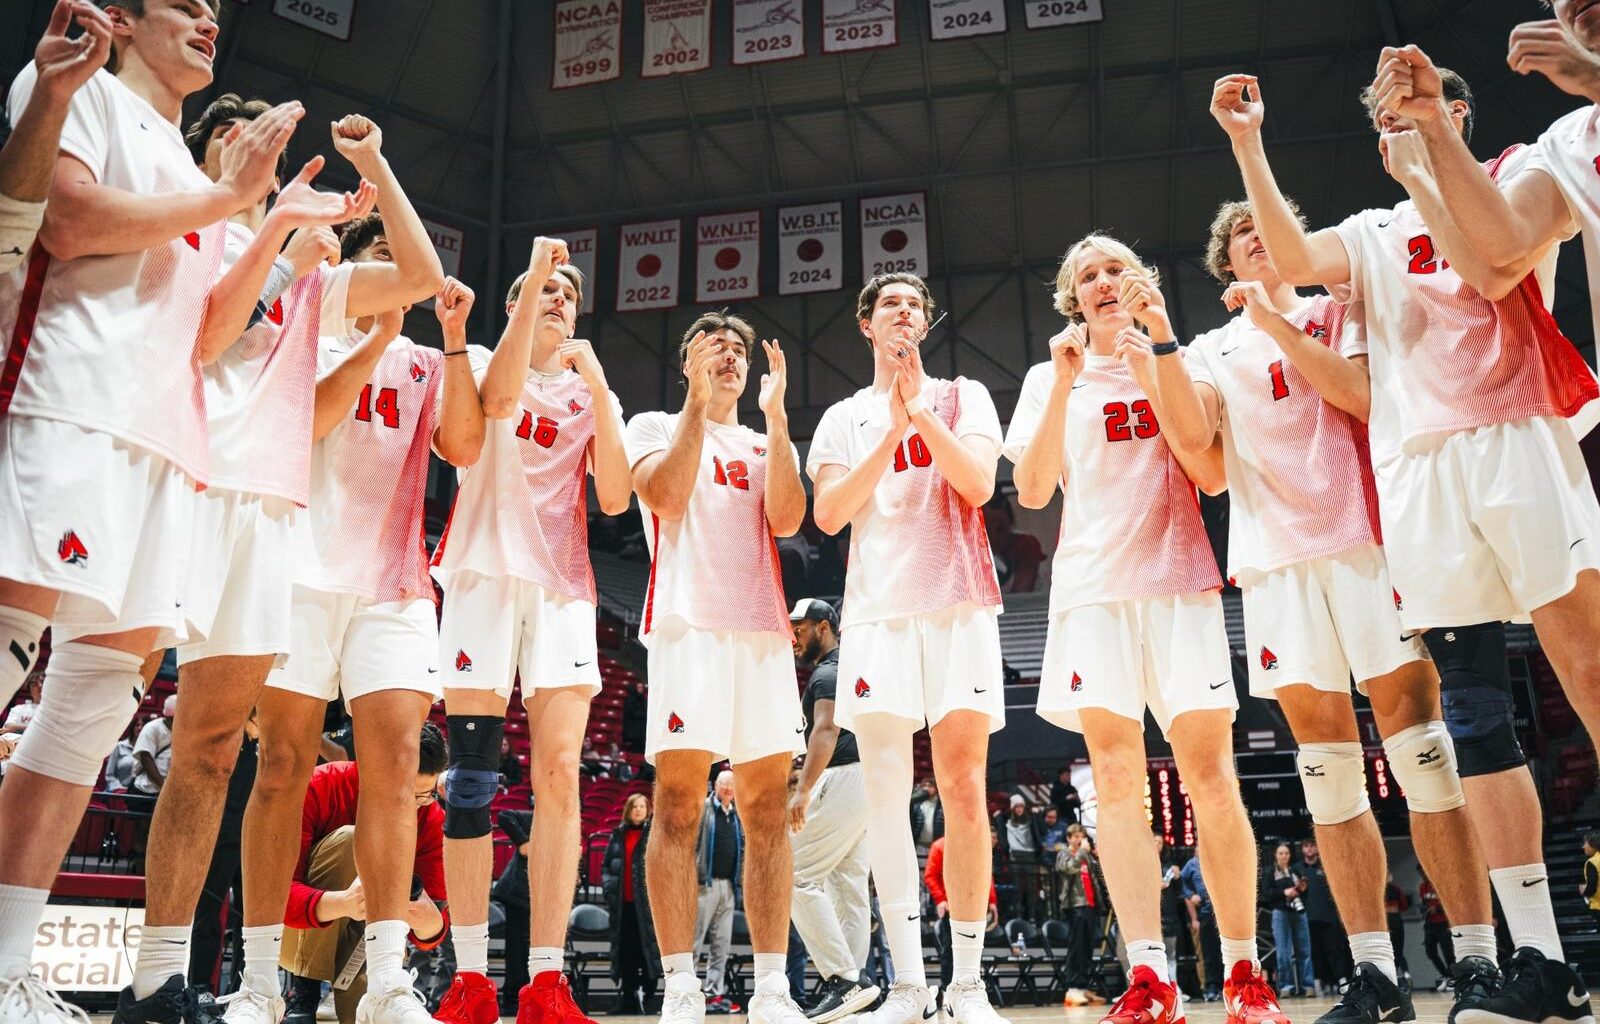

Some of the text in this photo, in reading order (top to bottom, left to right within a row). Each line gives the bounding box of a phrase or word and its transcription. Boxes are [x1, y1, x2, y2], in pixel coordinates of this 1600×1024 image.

[287, 0, 338, 26] 2025
[558, 2, 619, 25] NCAA
[1038, 0, 1089, 17] 2024
[943, 11, 993, 29] 2024
[835, 24, 884, 41] 2023
[744, 35, 793, 53] 2023
[653, 49, 699, 67] 2002
[563, 58, 611, 79] 1999
[782, 211, 840, 231] W.B.I.T.
[865, 203, 921, 221] NCAA
[625, 229, 677, 247] W.N.I.T.
[700, 220, 757, 240] W.N.I.T.
[1408, 234, 1451, 274] 2
[789, 268, 832, 284] 2024
[874, 258, 917, 276] 2025
[706, 276, 749, 292] 2023
[625, 286, 671, 303] 2022
[1268, 359, 1290, 401] 1
[355, 383, 400, 428] 14
[1103, 399, 1160, 442] 23
[894, 433, 933, 473] 10
[712, 455, 749, 491] 12
[1252, 810, 1275, 818] PLAYER
[35, 916, 142, 949] state
